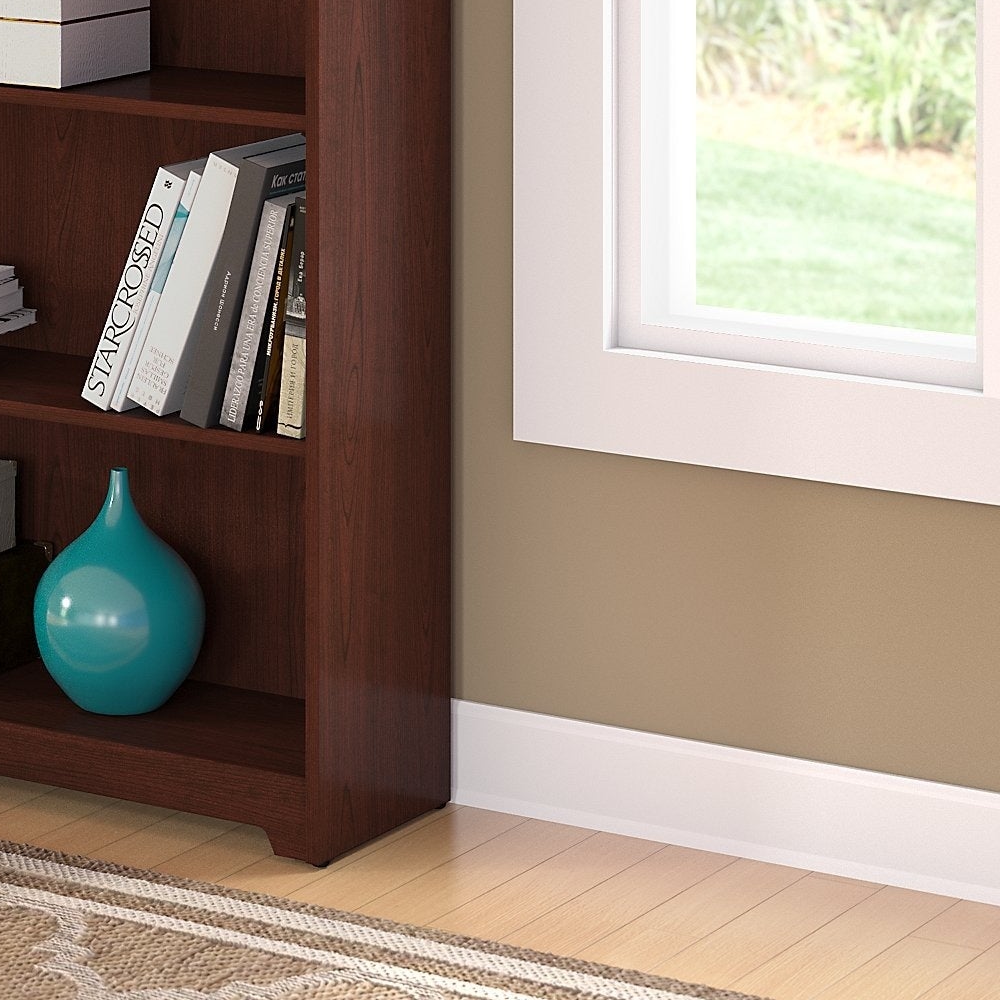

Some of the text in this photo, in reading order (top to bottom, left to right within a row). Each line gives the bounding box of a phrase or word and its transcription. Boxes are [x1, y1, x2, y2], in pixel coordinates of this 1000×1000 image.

[271, 171, 306, 188] Как стат
[88, 202, 165, 396] STARCROSSED
[134, 232, 164, 314] JOSEPHINE ANGELINE
[227, 209, 278, 423] LIDERAZGO PARA UNA ERA de CONCIENCIA SUPERIOR
[289, 343, 298, 370] ГОРОД
[286, 380, 296, 419] ИМПЕРИЯ
